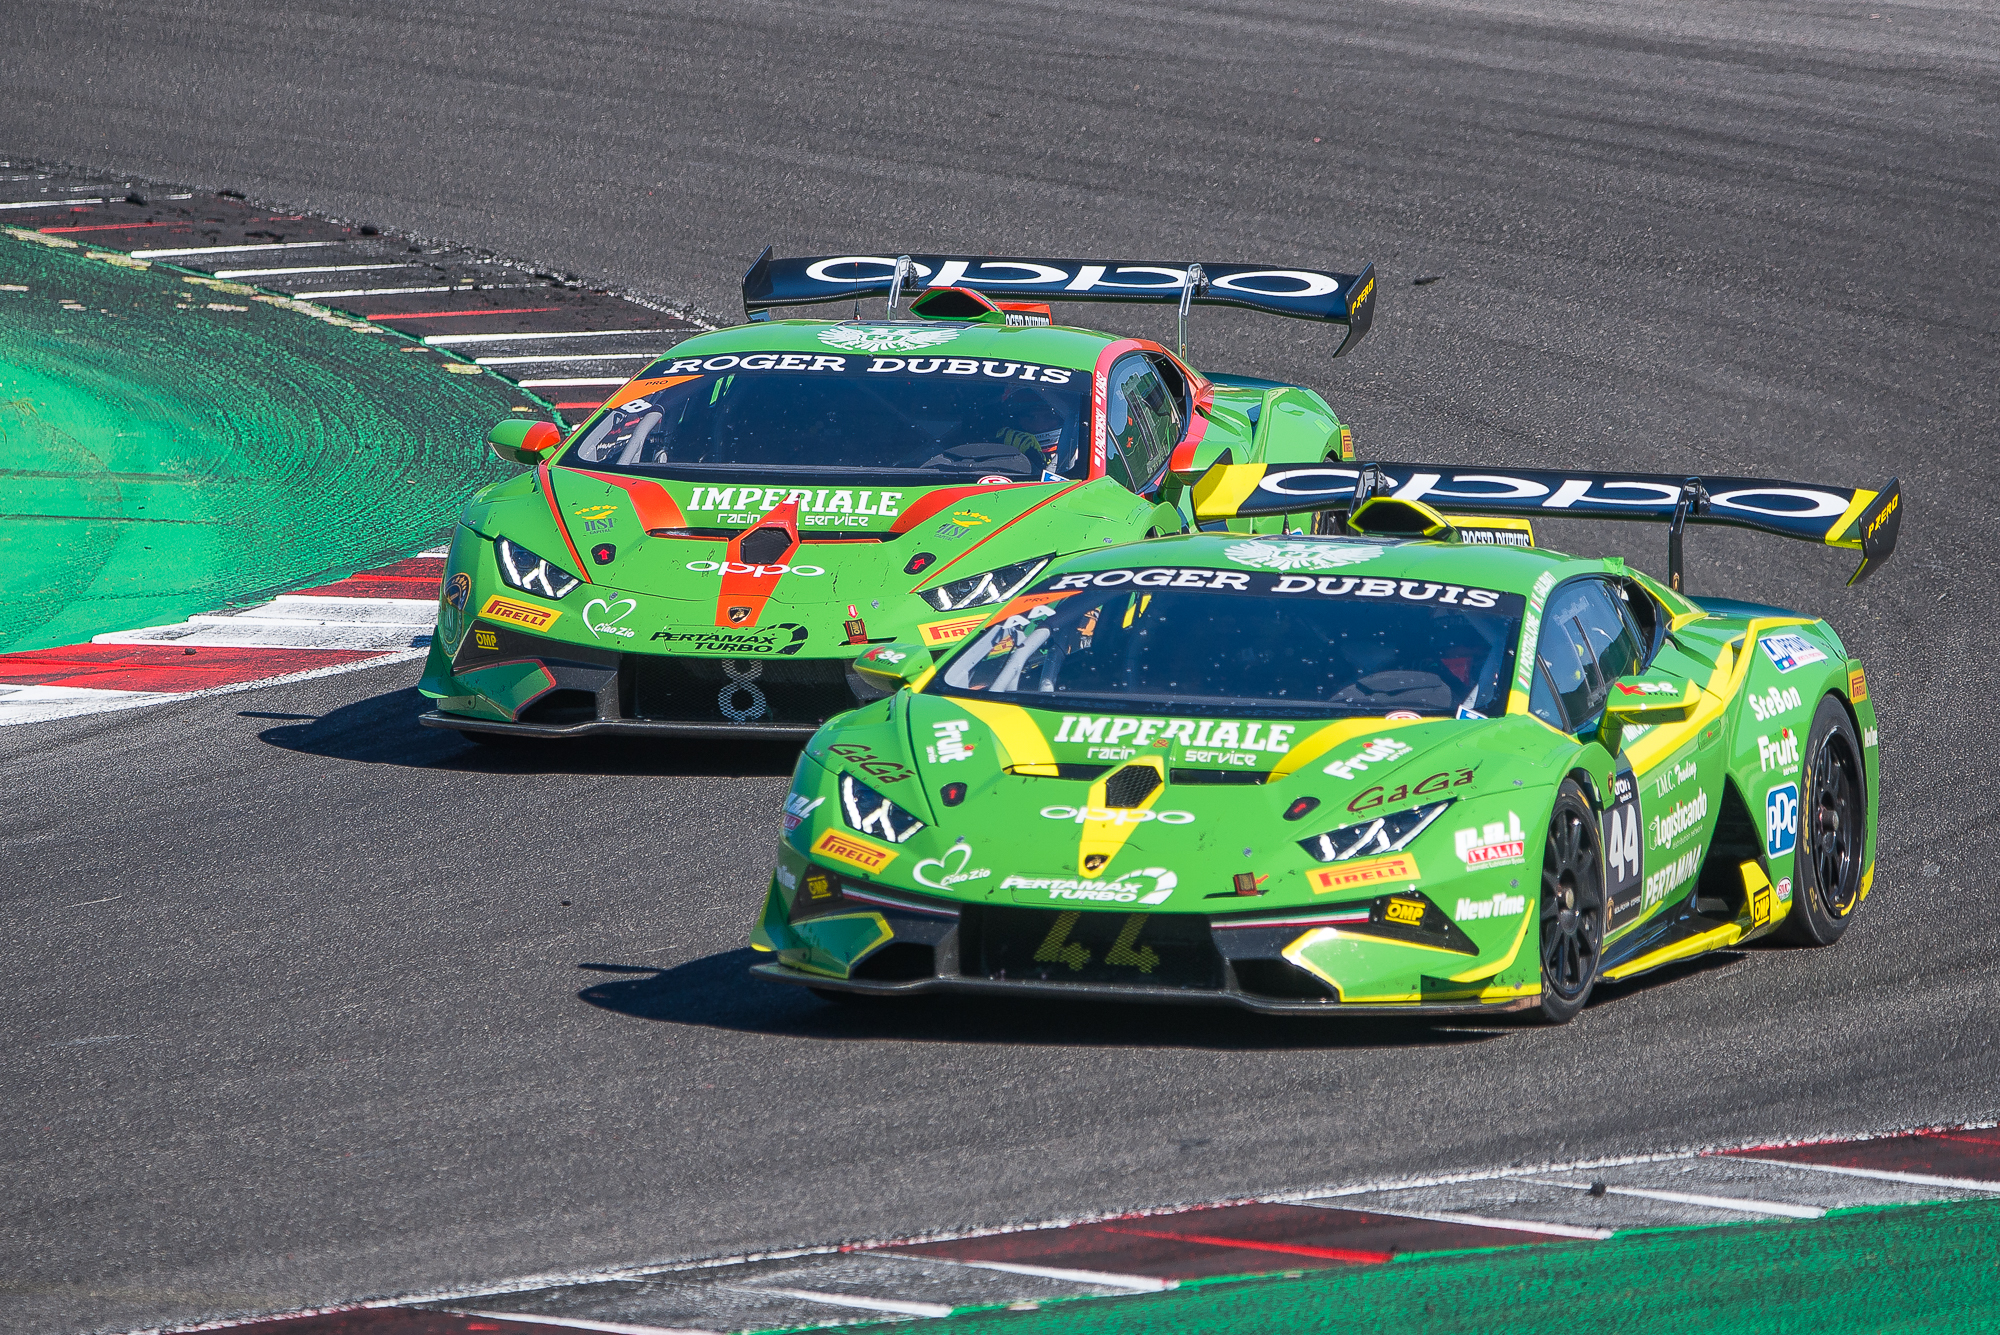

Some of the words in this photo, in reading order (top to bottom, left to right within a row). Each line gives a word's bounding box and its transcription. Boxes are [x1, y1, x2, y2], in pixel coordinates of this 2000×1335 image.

[805, 256, 1339, 297] oppo
[663, 354, 846, 374] ROGER
[866, 357, 1072, 384] DUBUIS
[686, 487, 902, 517] IMPERIALE
[1258, 468, 1852, 518] oppo
[717, 511, 762, 524] racin
[805, 513, 869, 527] service
[686, 560, 826, 578] oppo
[1049, 568, 1251, 591] ROGER
[1270, 575, 1500, 608] DUBUIS
[487, 600, 551, 627] PIRELLI
[475, 633, 497, 647] OMP
[594, 623, 617, 634] Ciao
[617, 626, 635, 638] Zio
[650, 631, 778, 645] PERTAMAX
[694, 642, 774, 653] TURBO
[717, 659, 767, 725] 8
[1748, 686, 1802, 722] SteBon
[932, 719, 974, 764] Fruit
[1053, 716, 1296, 753] IMPERIALE
[1185, 749, 1258, 767] service
[1323, 738, 1407, 781] Fruit
[1757, 728, 1800, 773] Fruit
[1040, 806, 1196, 826] oppo
[820, 835, 886, 867] PIRELLI
[1469, 843, 1522, 863] ITALIA
[1609, 804, 1639, 883] 44
[968, 868, 991, 881] Zio
[1000, 876, 1143, 893] PERTAMAX
[1318, 860, 1408, 888] PIRELLI
[1049, 889, 1138, 902] TURBO
[1755, 896, 1770, 921] OMP
[1387, 903, 1424, 921] OMP
